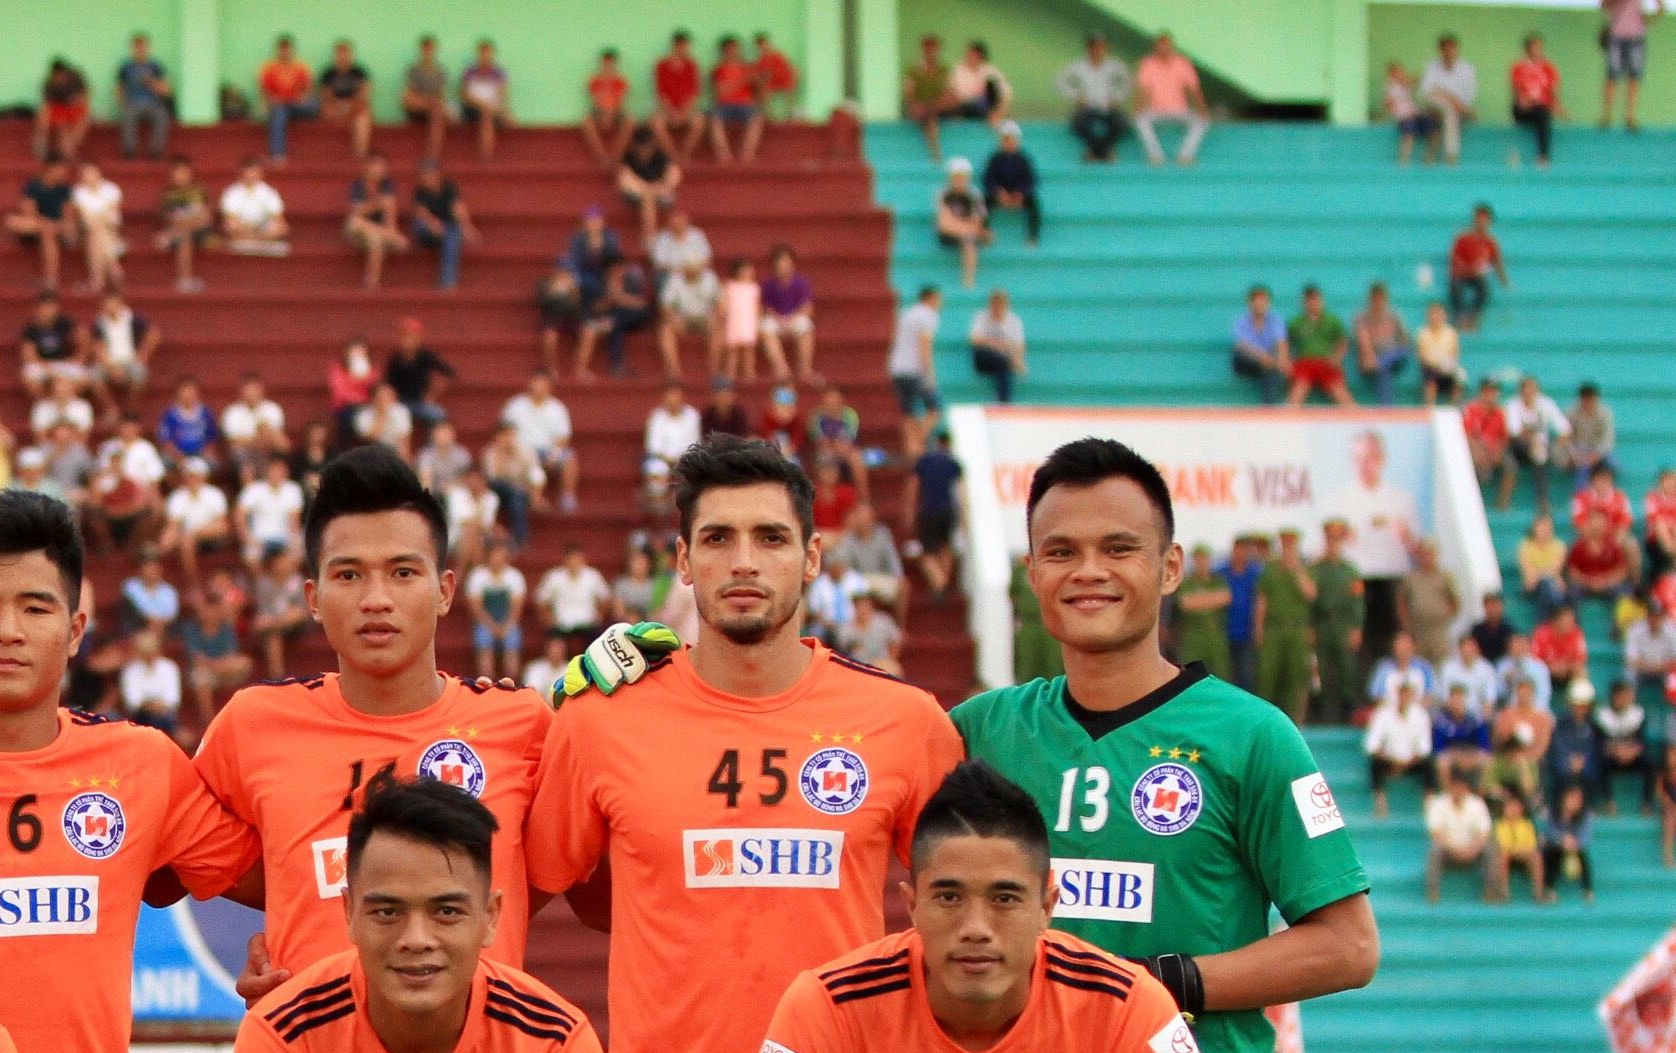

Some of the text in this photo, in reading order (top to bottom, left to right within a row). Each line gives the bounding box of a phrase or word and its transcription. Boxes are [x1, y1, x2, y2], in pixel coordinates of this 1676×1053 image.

[1250, 462, 1312, 505] VISA
[707, 748, 789, 809] 45
[1053, 766, 1111, 832] 13
[740, 838, 833, 876] SHB
[1059, 869, 1142, 910] SHB
